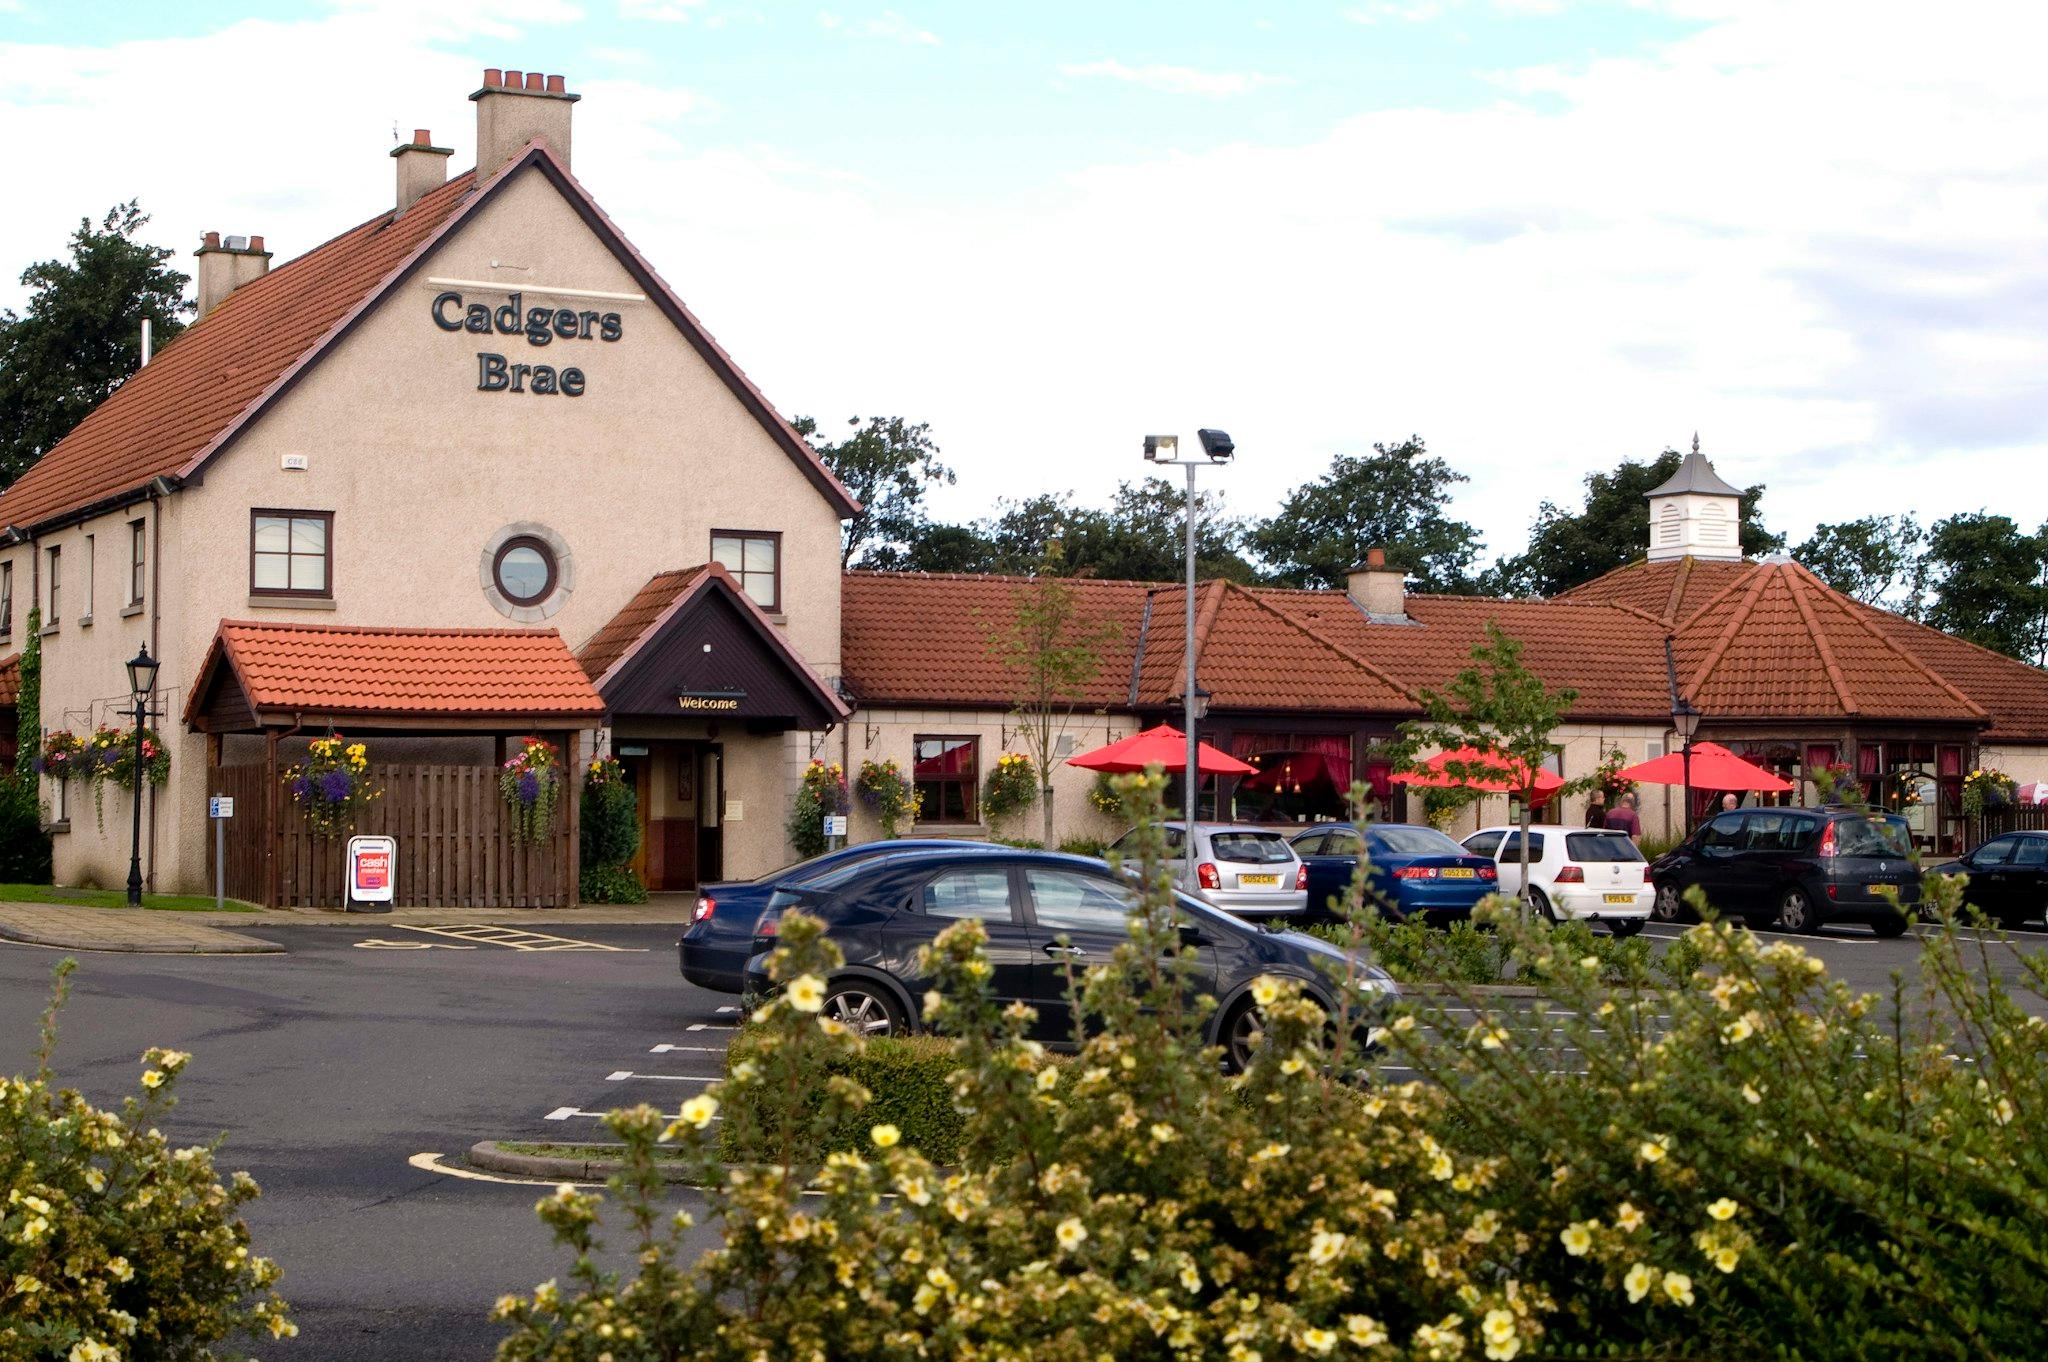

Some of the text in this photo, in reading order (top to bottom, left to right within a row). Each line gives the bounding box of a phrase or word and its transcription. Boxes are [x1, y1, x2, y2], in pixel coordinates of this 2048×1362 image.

[432, 291, 623, 346] Cadgers
[477, 352, 585, 397] Brae
[679, 696, 738, 709] Welcome
[360, 856, 387, 868] cash
